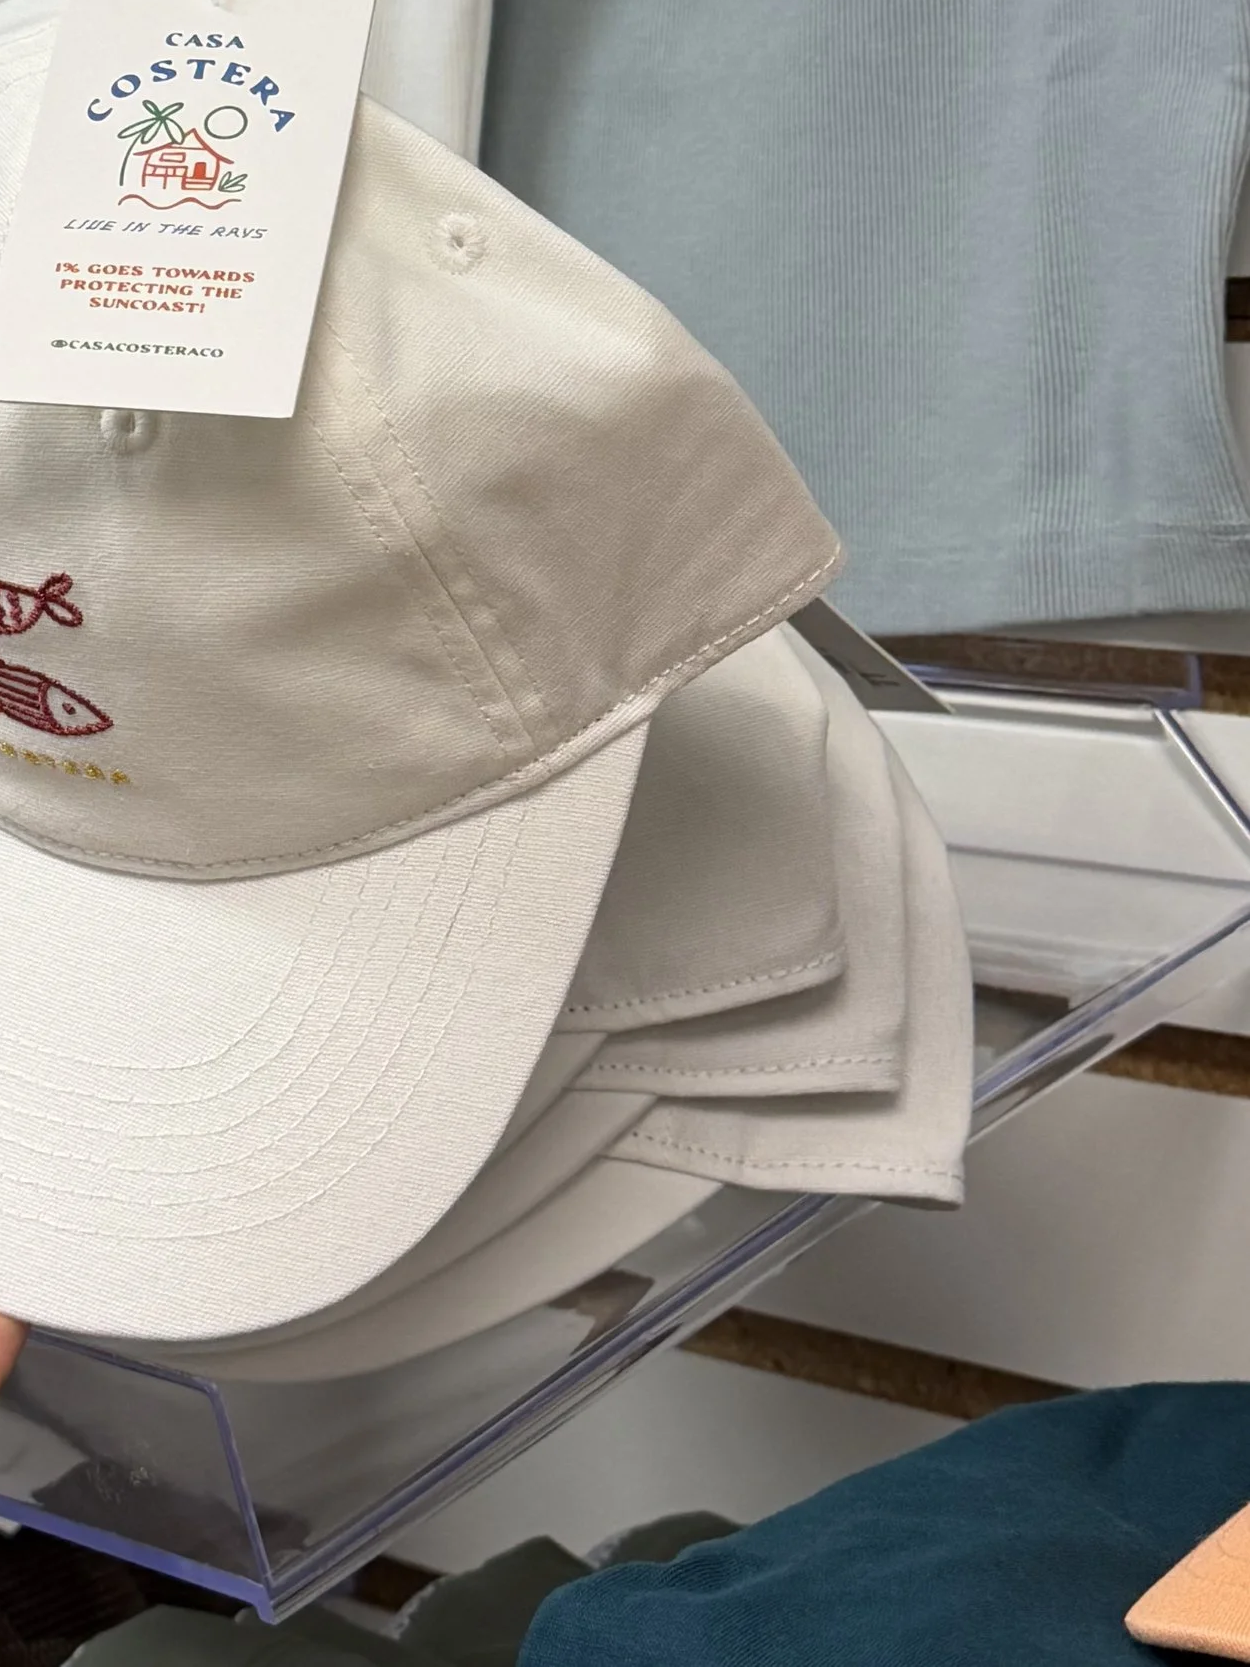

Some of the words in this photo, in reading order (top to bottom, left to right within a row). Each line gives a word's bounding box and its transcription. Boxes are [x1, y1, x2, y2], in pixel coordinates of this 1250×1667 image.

[165, 32, 245, 49] CASA
[87, 58, 295, 132] COSTERA
[122, 221, 151, 233] IN
[158, 223, 203, 235] THE
[210, 226, 268, 239] RAYS
[55, 262, 80, 273] 1%
[87, 264, 144, 276] GOES
[152, 266, 255, 283] TOWARDS
[60, 278, 194, 296] PROTECTING
[201, 286, 244, 299] THE
[89, 297, 206, 313] SUNCOAST!
[51, 339, 225, 358] @CASACOSTERACO
